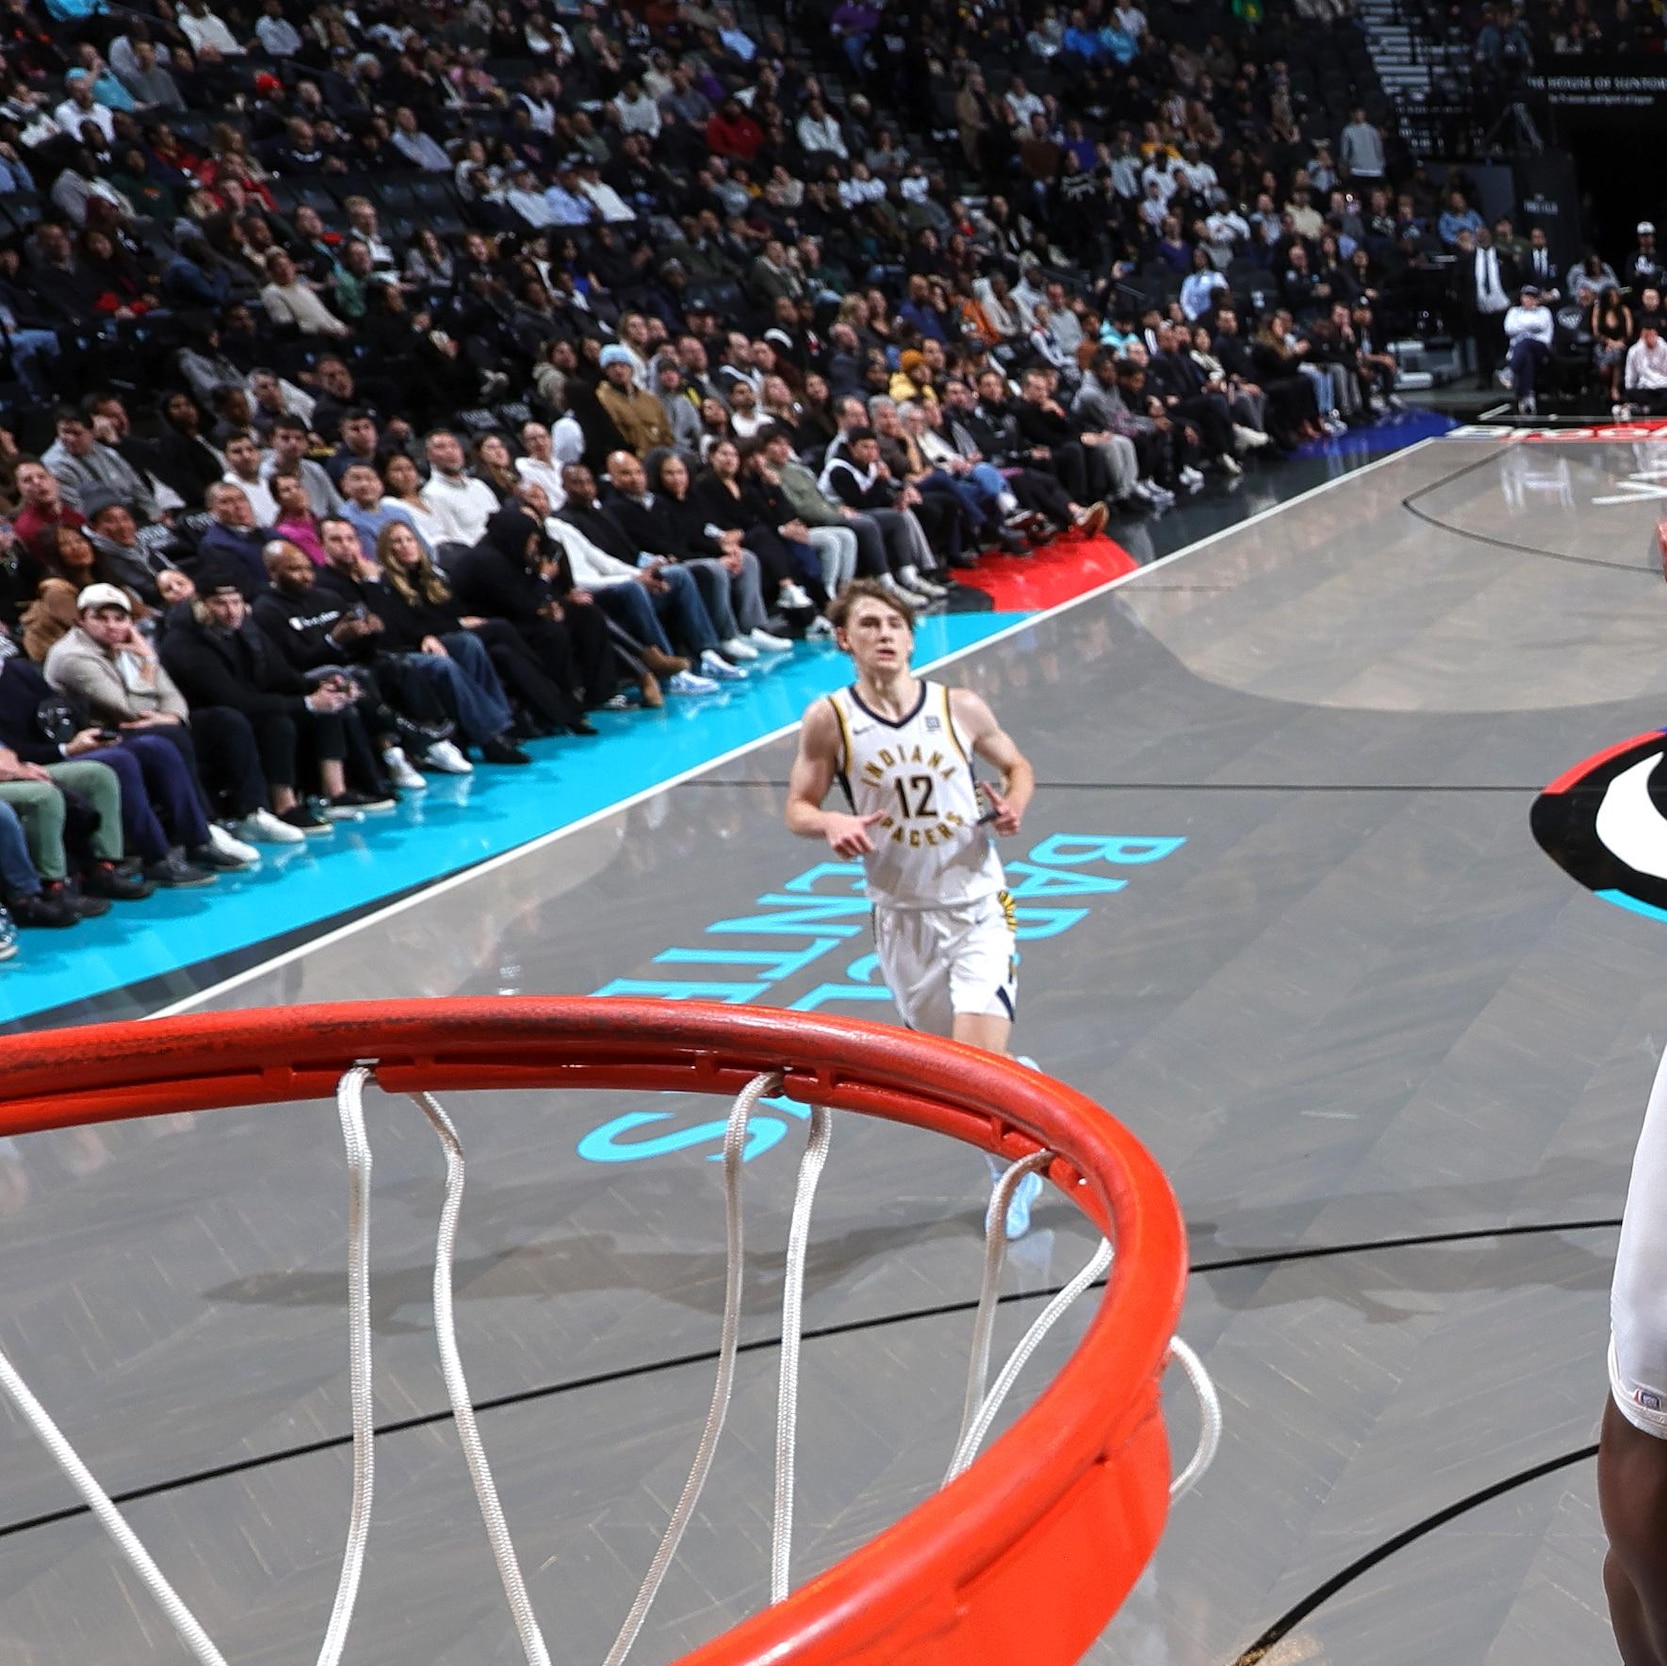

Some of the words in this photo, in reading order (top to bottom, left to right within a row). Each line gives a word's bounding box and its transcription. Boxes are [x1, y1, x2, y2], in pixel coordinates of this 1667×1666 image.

[860, 744, 956, 788] INDIANA
[894, 775, 938, 818] 12
[880, 812, 963, 848] PACERS
